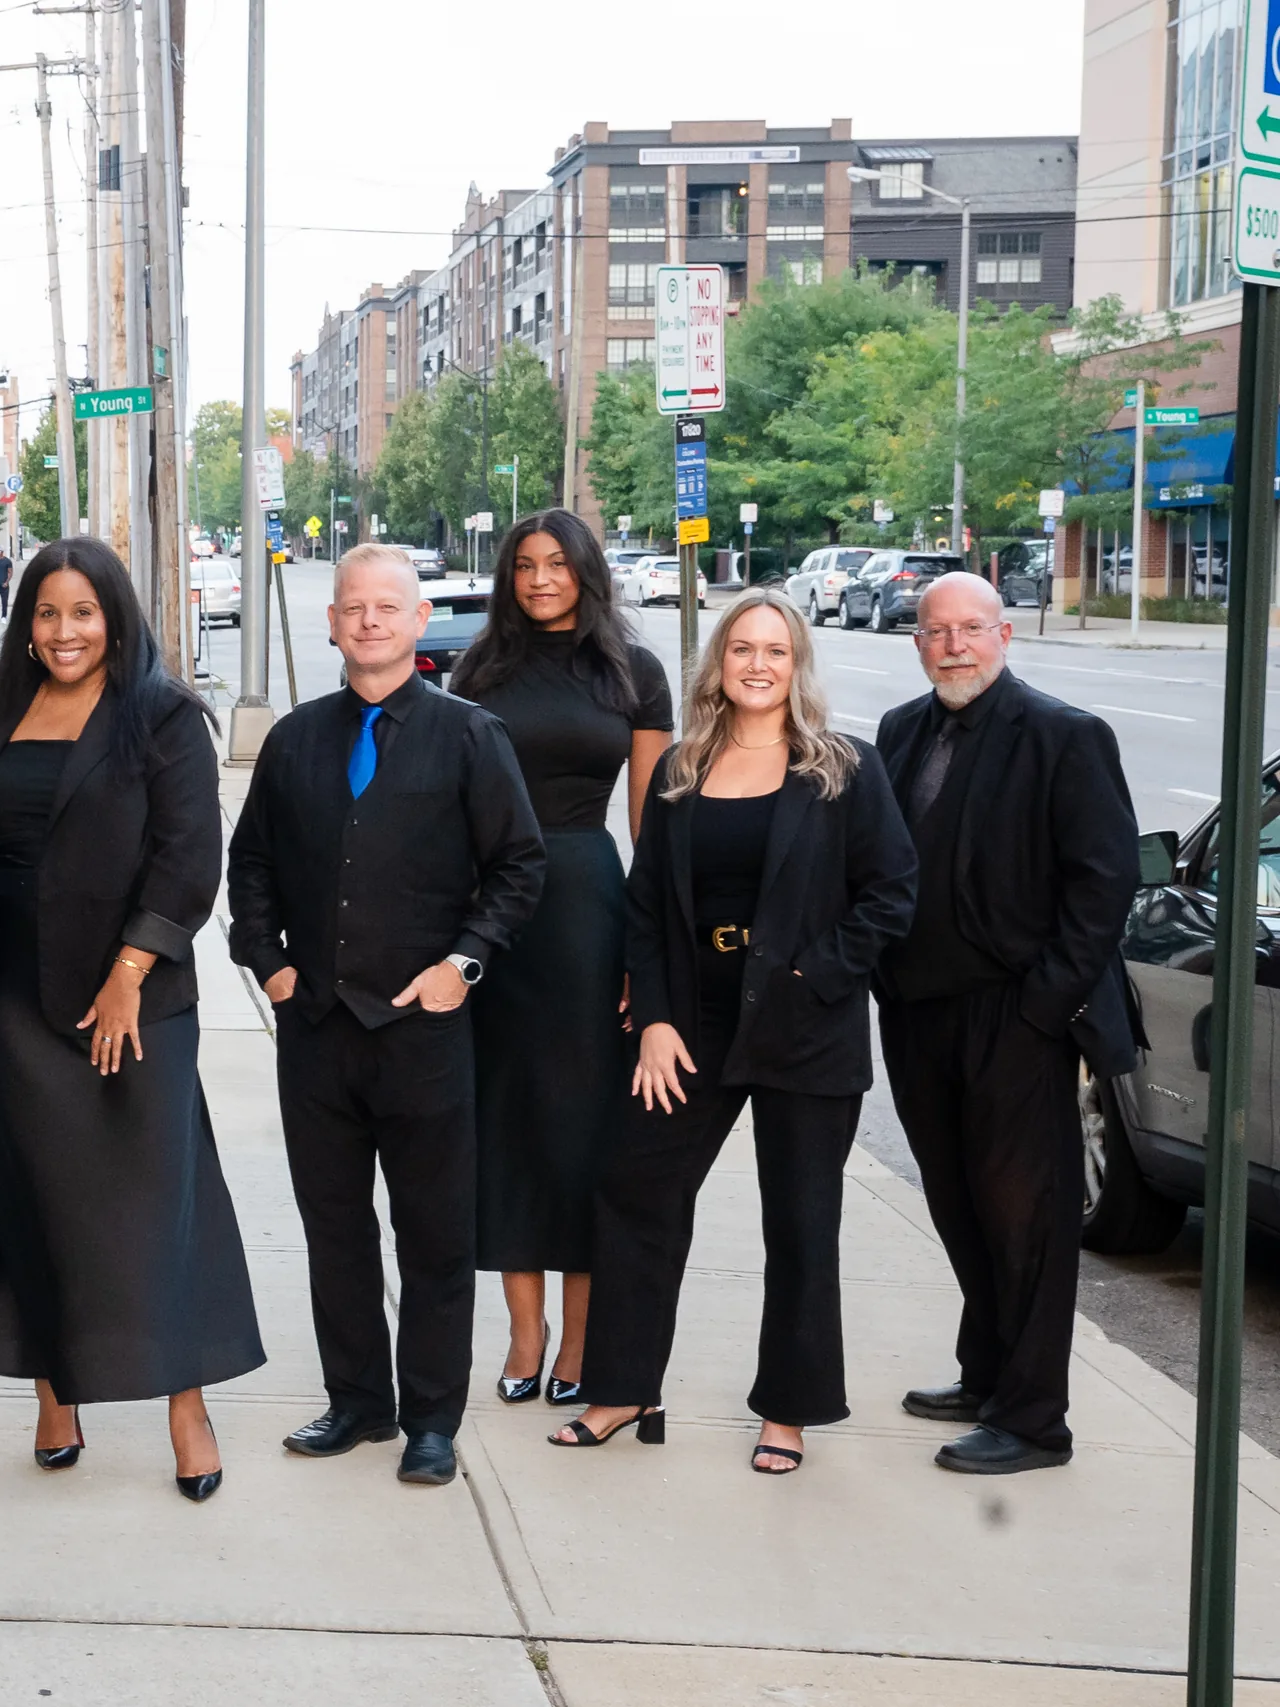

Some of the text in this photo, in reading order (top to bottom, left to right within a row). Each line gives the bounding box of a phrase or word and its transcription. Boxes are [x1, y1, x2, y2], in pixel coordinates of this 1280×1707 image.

[697, 278, 711, 300] NO
[689, 305, 719, 327] STOPPING
[696, 332, 713, 350] ANY
[695, 354, 715, 373] TIME
[90, 397, 133, 414] Young
[137, 396, 147, 405] St
[1155, 411, 1187, 425] Young
